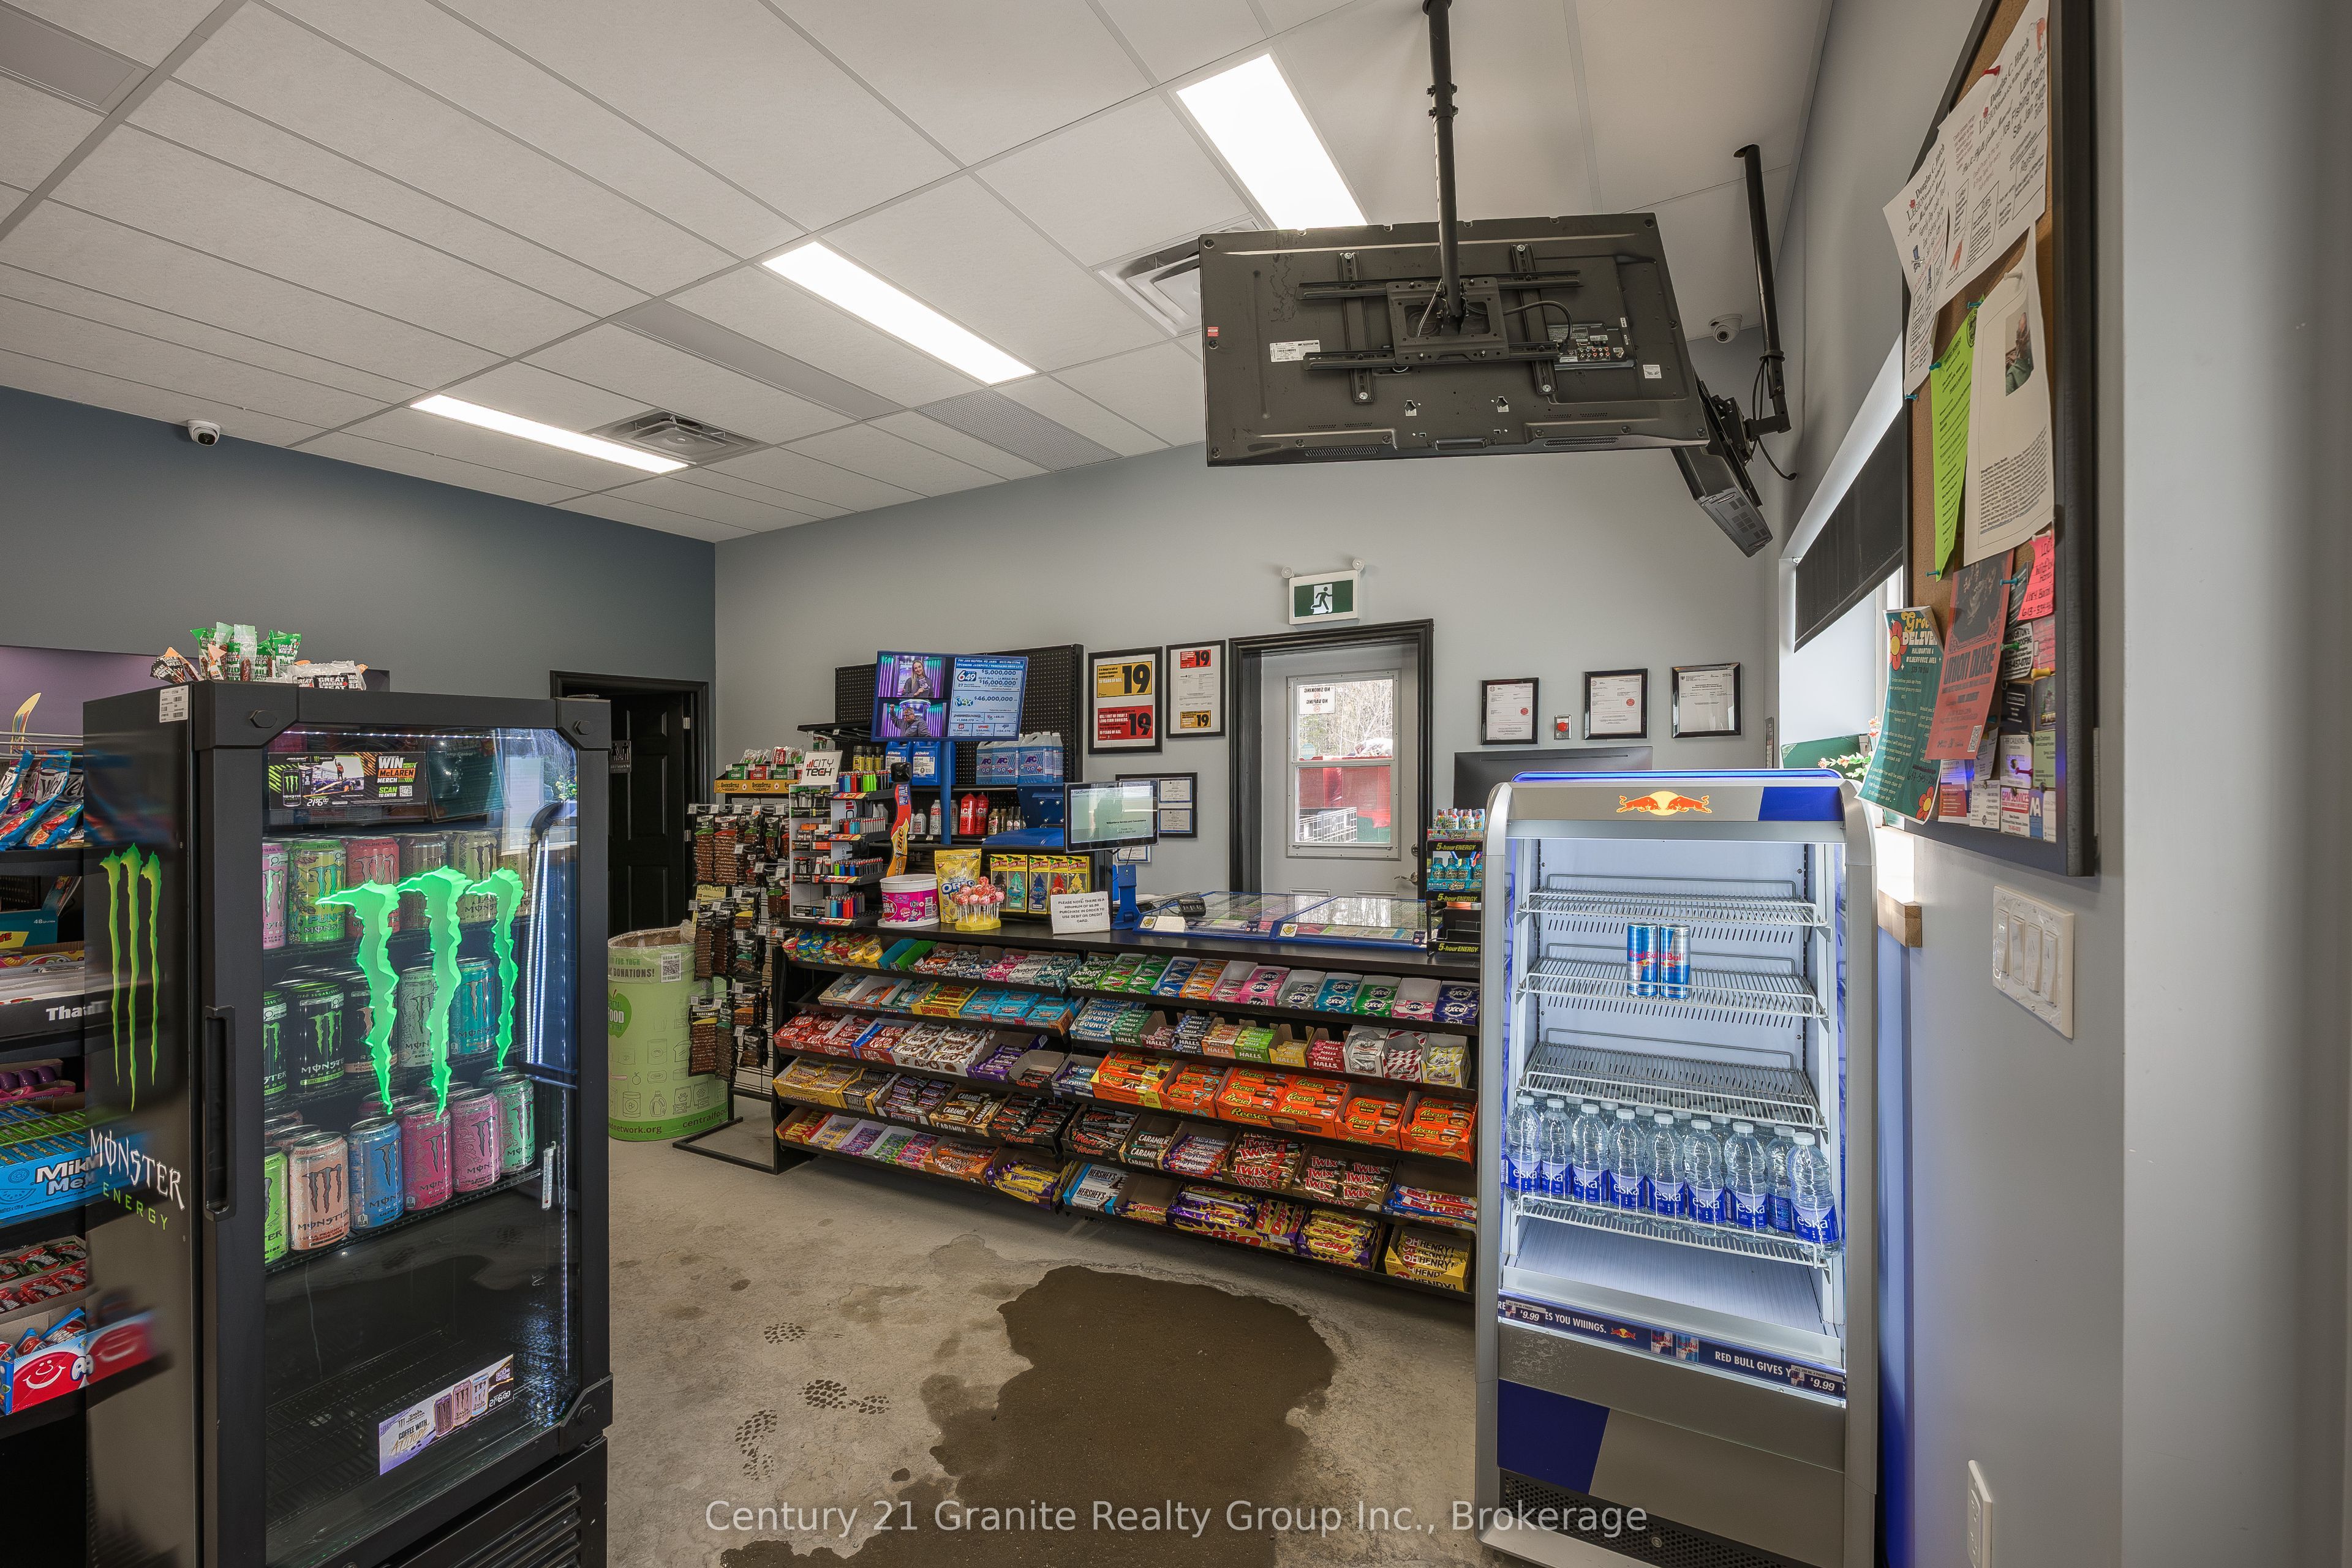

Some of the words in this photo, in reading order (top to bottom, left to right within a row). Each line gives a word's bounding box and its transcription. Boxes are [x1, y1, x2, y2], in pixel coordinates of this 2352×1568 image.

[1196, 650, 1210, 666] 19
[1122, 663, 1151, 694] 19
[1129, 712, 1152, 736] 19
[1197, 714, 1209, 727] 19
[379, 757, 404, 768] WIN
[813, 758, 834, 769] CITY
[806, 767, 832, 777] TECH
[304, 923, 345, 933] MONSTE
[1646, 951, 1658, 959] Bul
[614, 968, 655, 978] DONATIONS!
[1251, 984, 1273, 992] excel
[1289, 993, 1310, 1002] excel
[608, 1008, 625, 1023] OOD
[1297, 1078, 1325, 1090] Reese's
[958, 1093, 981, 1102] CARAMILK
[1355, 1099, 1382, 1110] Reese's
[891, 1113, 915, 1123] SNICKERS
[943, 1106, 968, 1117] CARAMILK
[1231, 1107, 1268, 1121] Reese's
[91, 1128, 185, 1211] MONSTER
[1513, 1167, 1539, 1180] eska
[1540, 1169, 1563, 1183] eska
[1574, 1174, 1598, 1189] eska
[1613, 1180, 1640, 1195] eska
[1001, 1183, 1029, 1196] WUNDERBAR
[1407, 1189, 1428, 1199] BIG
[1428, 1191, 1462, 1202] TURK
[1654, 1189, 1682, 1202] eska
[103, 1182, 168, 1231] ENERGY
[1410, 1200, 1431, 1211] BIG
[1432, 1203, 1467, 1215] TURK
[1692, 1195, 1720, 1209] eska
[1737, 1200, 1765, 1215] eska
[1797, 1213, 1828, 1229] eska
[1419, 1240, 1455, 1254] HENRY!
[1419, 1256, 1455, 1271] HENRY!
[1520, 1310, 1540, 1322] $9.99
[1555, 1313, 1570, 1325] YOU
[1715, 1351, 1732, 1363] RED
[1734, 1355, 1755, 1369] BULL
[1757, 1361, 1783, 1375] GIVES
[1810, 1377, 1835, 1392] $9.99
[398, 1427, 415, 1440] COFFEE
[415, 1419, 428, 1430] WITH
